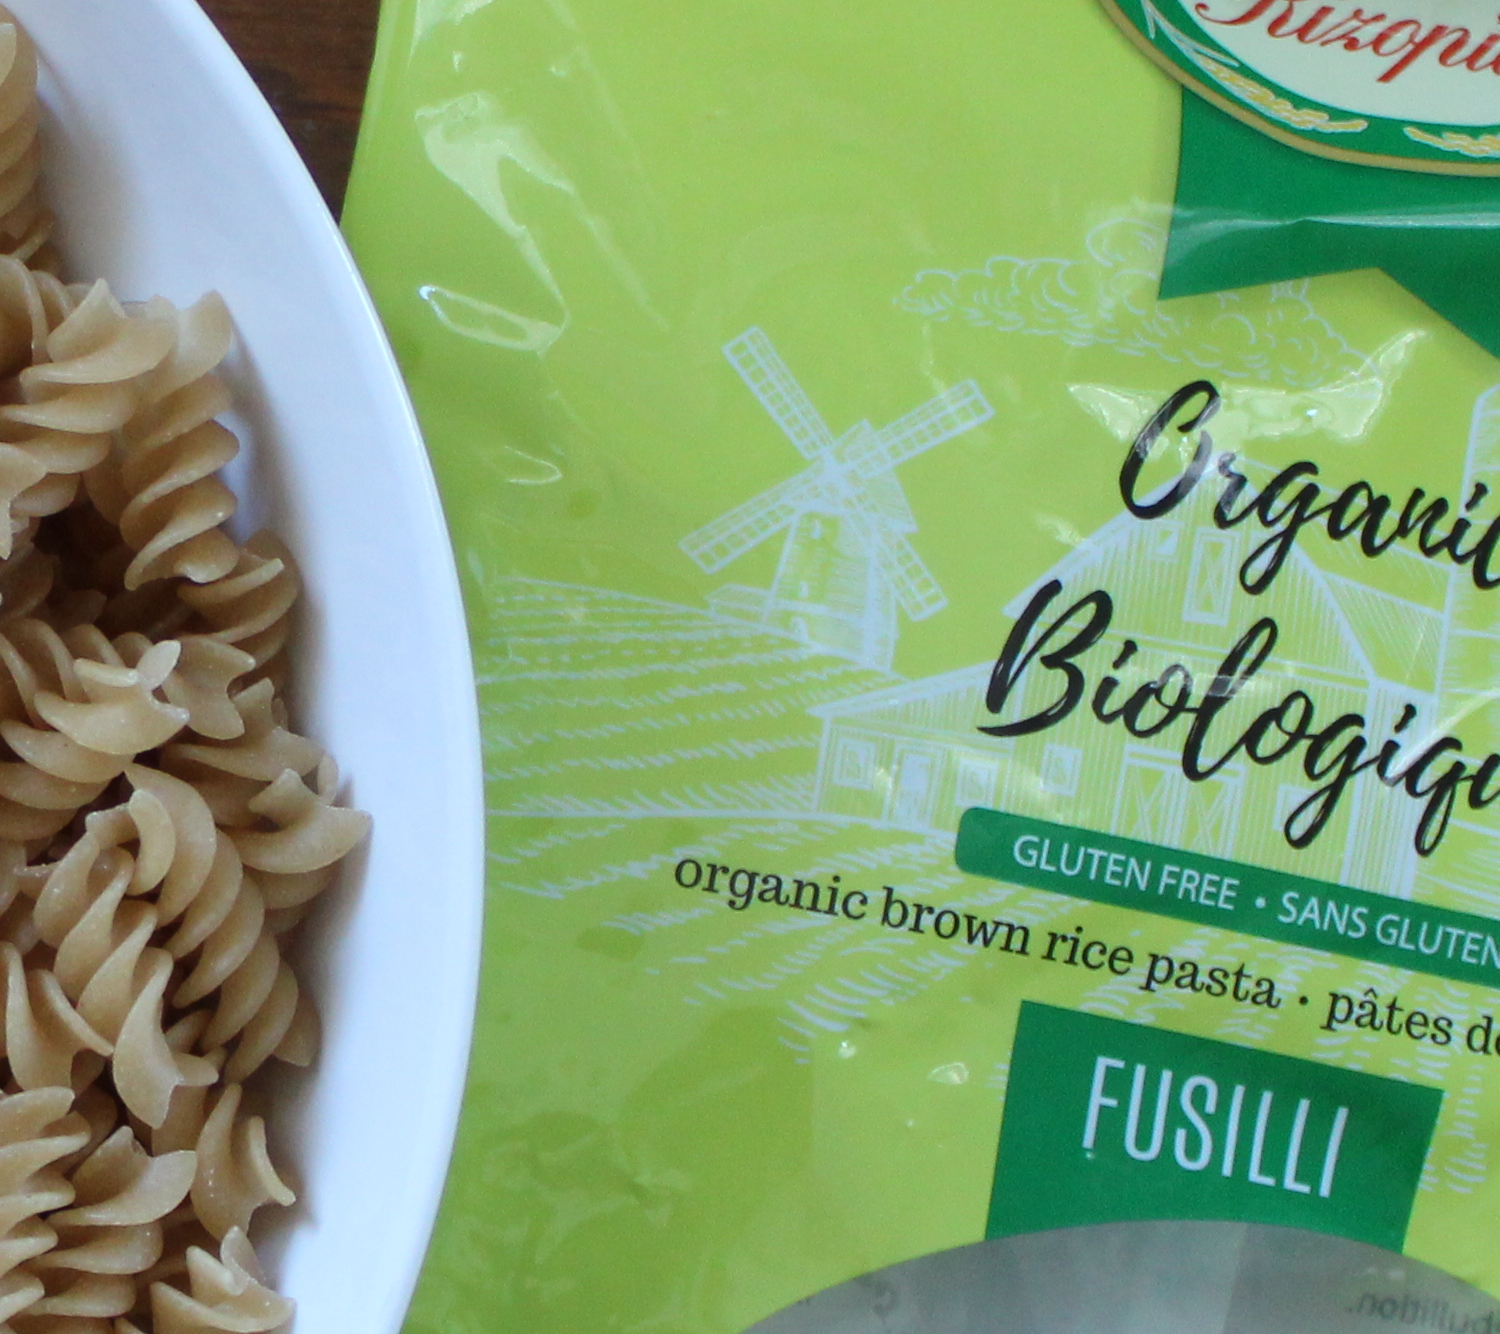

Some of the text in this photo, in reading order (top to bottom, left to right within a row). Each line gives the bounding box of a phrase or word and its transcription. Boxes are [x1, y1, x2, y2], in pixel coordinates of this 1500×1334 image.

[674, 856, 869, 922] organic
[880, 885, 1032, 957] brown
[1040, 924, 1135, 978] rice
[1138, 948, 1282, 1009] pasta
[1320, 987, 1454, 1047] pâtes
[1012, 833, 1154, 894] GLUTEN
[1157, 863, 1241, 911] FREE
[1277, 890, 1369, 940] SANS
[1081, 1054, 1351, 1199] FUSILLI
